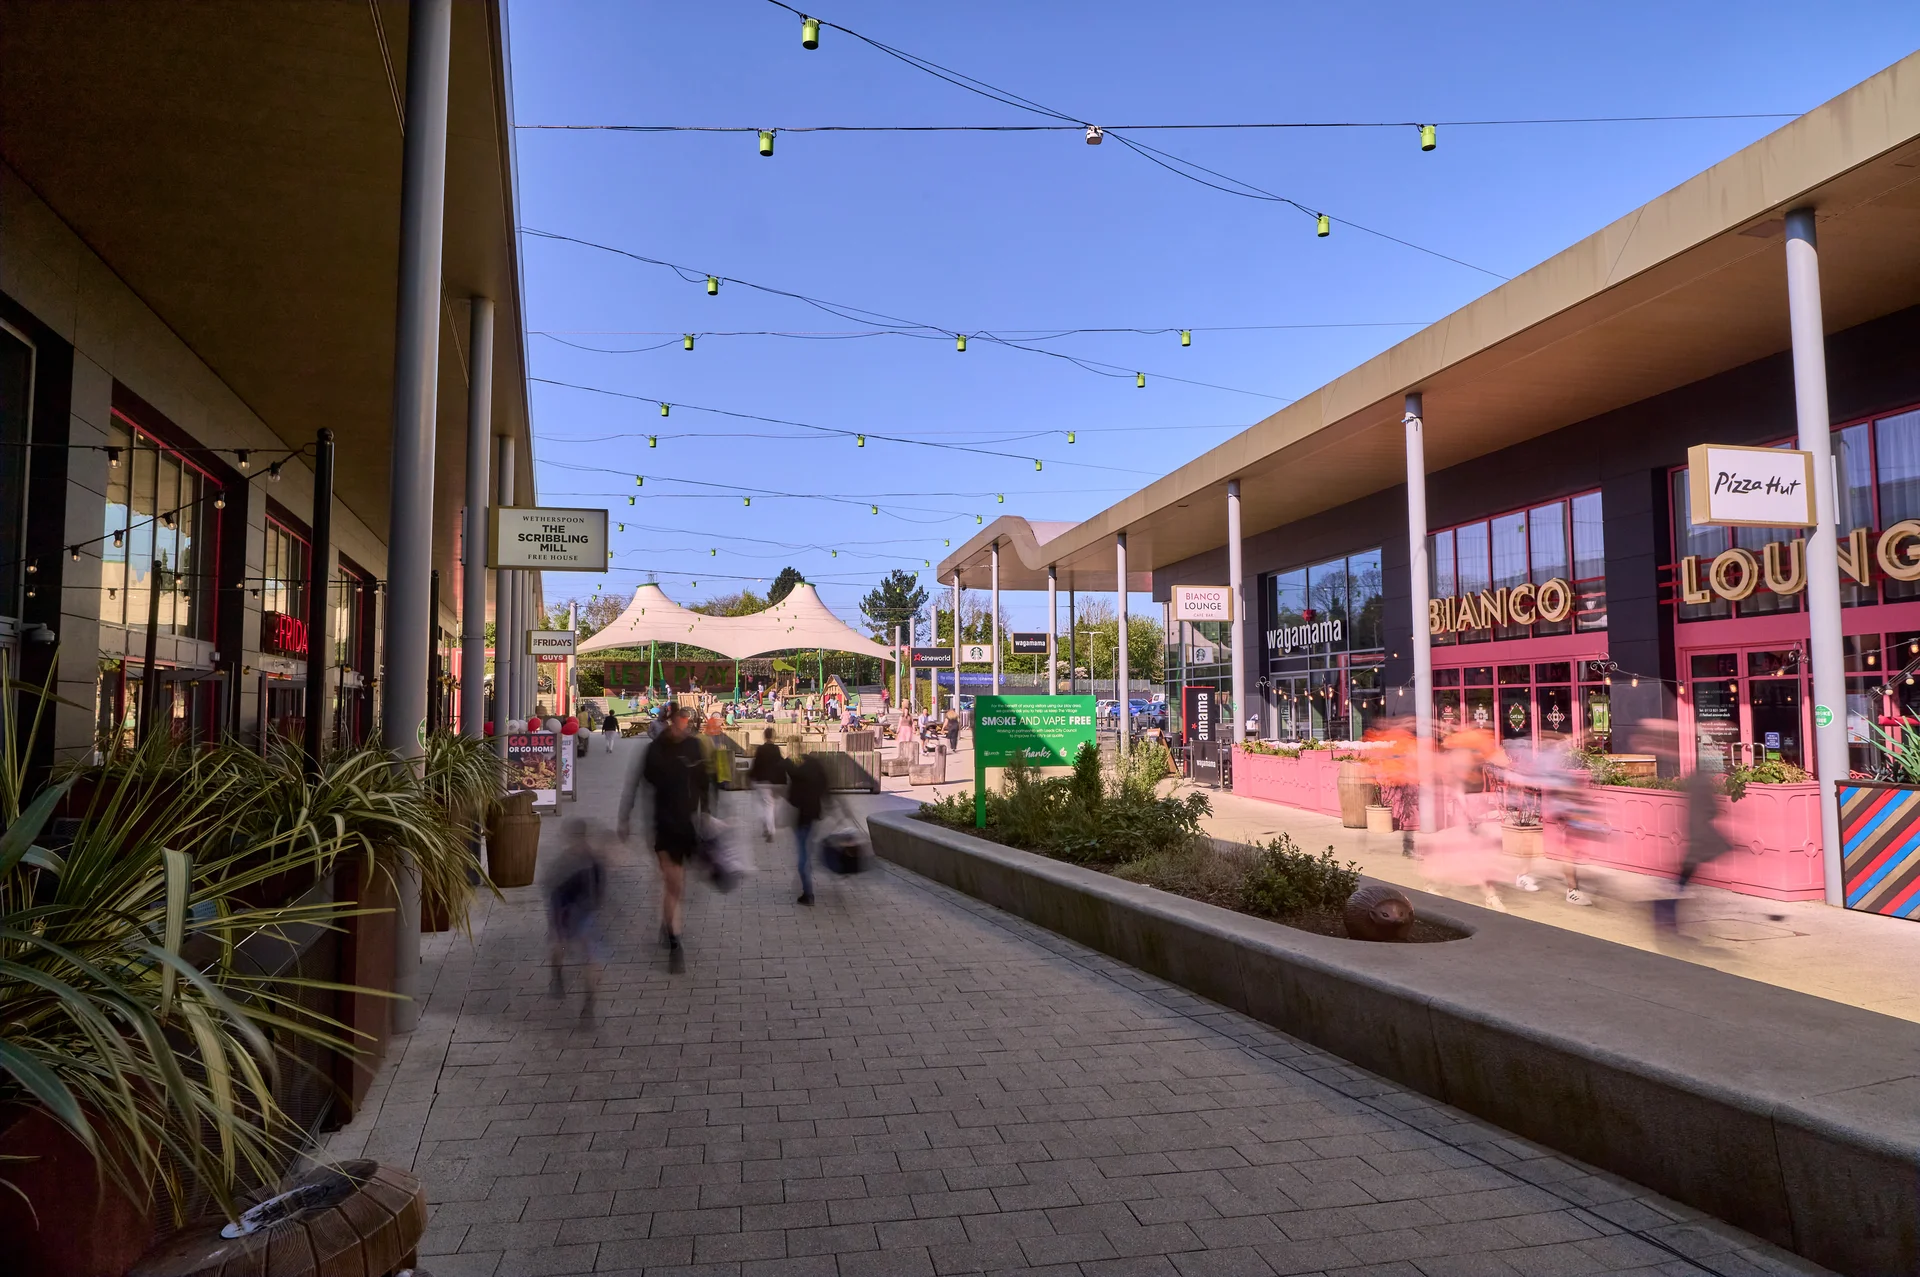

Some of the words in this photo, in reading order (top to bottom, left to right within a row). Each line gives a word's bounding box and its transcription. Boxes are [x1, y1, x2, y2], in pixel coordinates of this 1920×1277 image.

[1714, 470, 1763, 496] Pizza
[1765, 475, 1801, 496] Hut
[522, 515, 585, 524] WETHERSPOON
[542, 524, 566, 534] THE
[518, 533, 589, 544] SCRIBBLING
[540, 543, 567, 552] MILL
[1681, 518, 1920, 605] LOUNG
[1185, 592, 1221, 601] BIANCO
[1185, 602, 1222, 611] LOUNGE
[1428, 576, 1573, 635] BIANCO
[279, 613, 309, 655] FRIDA
[1266, 619, 1342, 654] wagamama
[538, 639, 572, 647] FRIDAYS
[1015, 639, 1046, 647] wagamama
[920, 654, 951, 662] cineworld
[981, 716, 1017, 726] SMOKE
[1019, 716, 1041, 726] AND
[1042, 716, 1066, 726] VAPE
[1069, 715, 1092, 726] FREE
[1197, 692, 1209, 741] amama
[508, 735, 528, 747] GO
[531, 735, 554, 746] BIG
